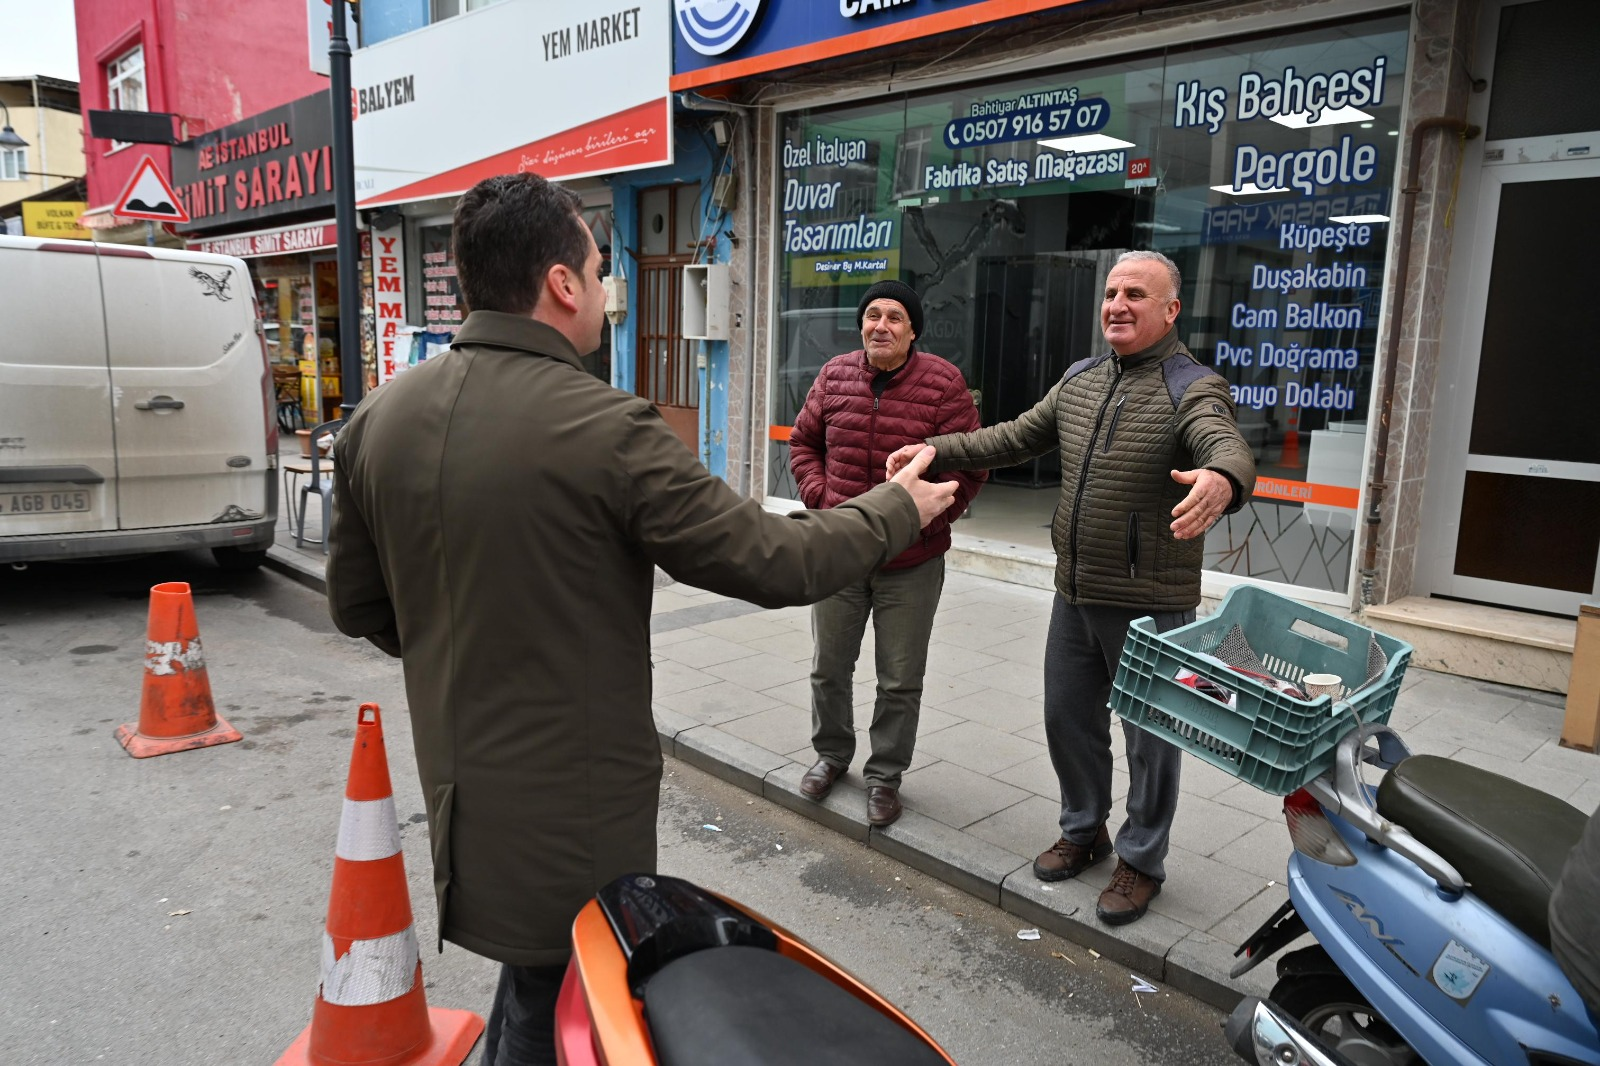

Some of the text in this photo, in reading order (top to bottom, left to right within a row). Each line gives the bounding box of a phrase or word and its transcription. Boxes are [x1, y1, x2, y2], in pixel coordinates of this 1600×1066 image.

[542, 7, 641, 62] YEM MARKET
[359, 74, 415, 115] BALYEM
[971, 87, 1079, 118] Bahtiyar ALTINTAŞ
[1176, 58, 1386, 133] Kış Bahçesi
[963, 105, 1102, 143] 0507 916 57 07
[199, 145, 214, 170] AE
[783, 135, 866, 170] Özel İtalyan
[1233, 136, 1376, 196] Pergole
[235, 146, 331, 210] SARAYI
[925, 151, 1125, 189] Fabrika Satış Mağazası
[784, 180, 841, 213] Duvar
[284, 227, 324, 250] SARAYI
[785, 215, 893, 252] Tasarımları
[1280, 223, 1371, 253] Küpeşte
[377, 237, 402, 292] YEM
[843, 261, 852, 272] By
[1253, 262, 1366, 294] Duşakabin
[1232, 303, 1362, 328] Cam Balkon
[1216, 342, 1358, 373] Pvc Doğrama
[1230, 381, 1355, 410] anyo Dolabı
[11, 494, 44, 512] AGB
[51, 493, 85, 510] 045
